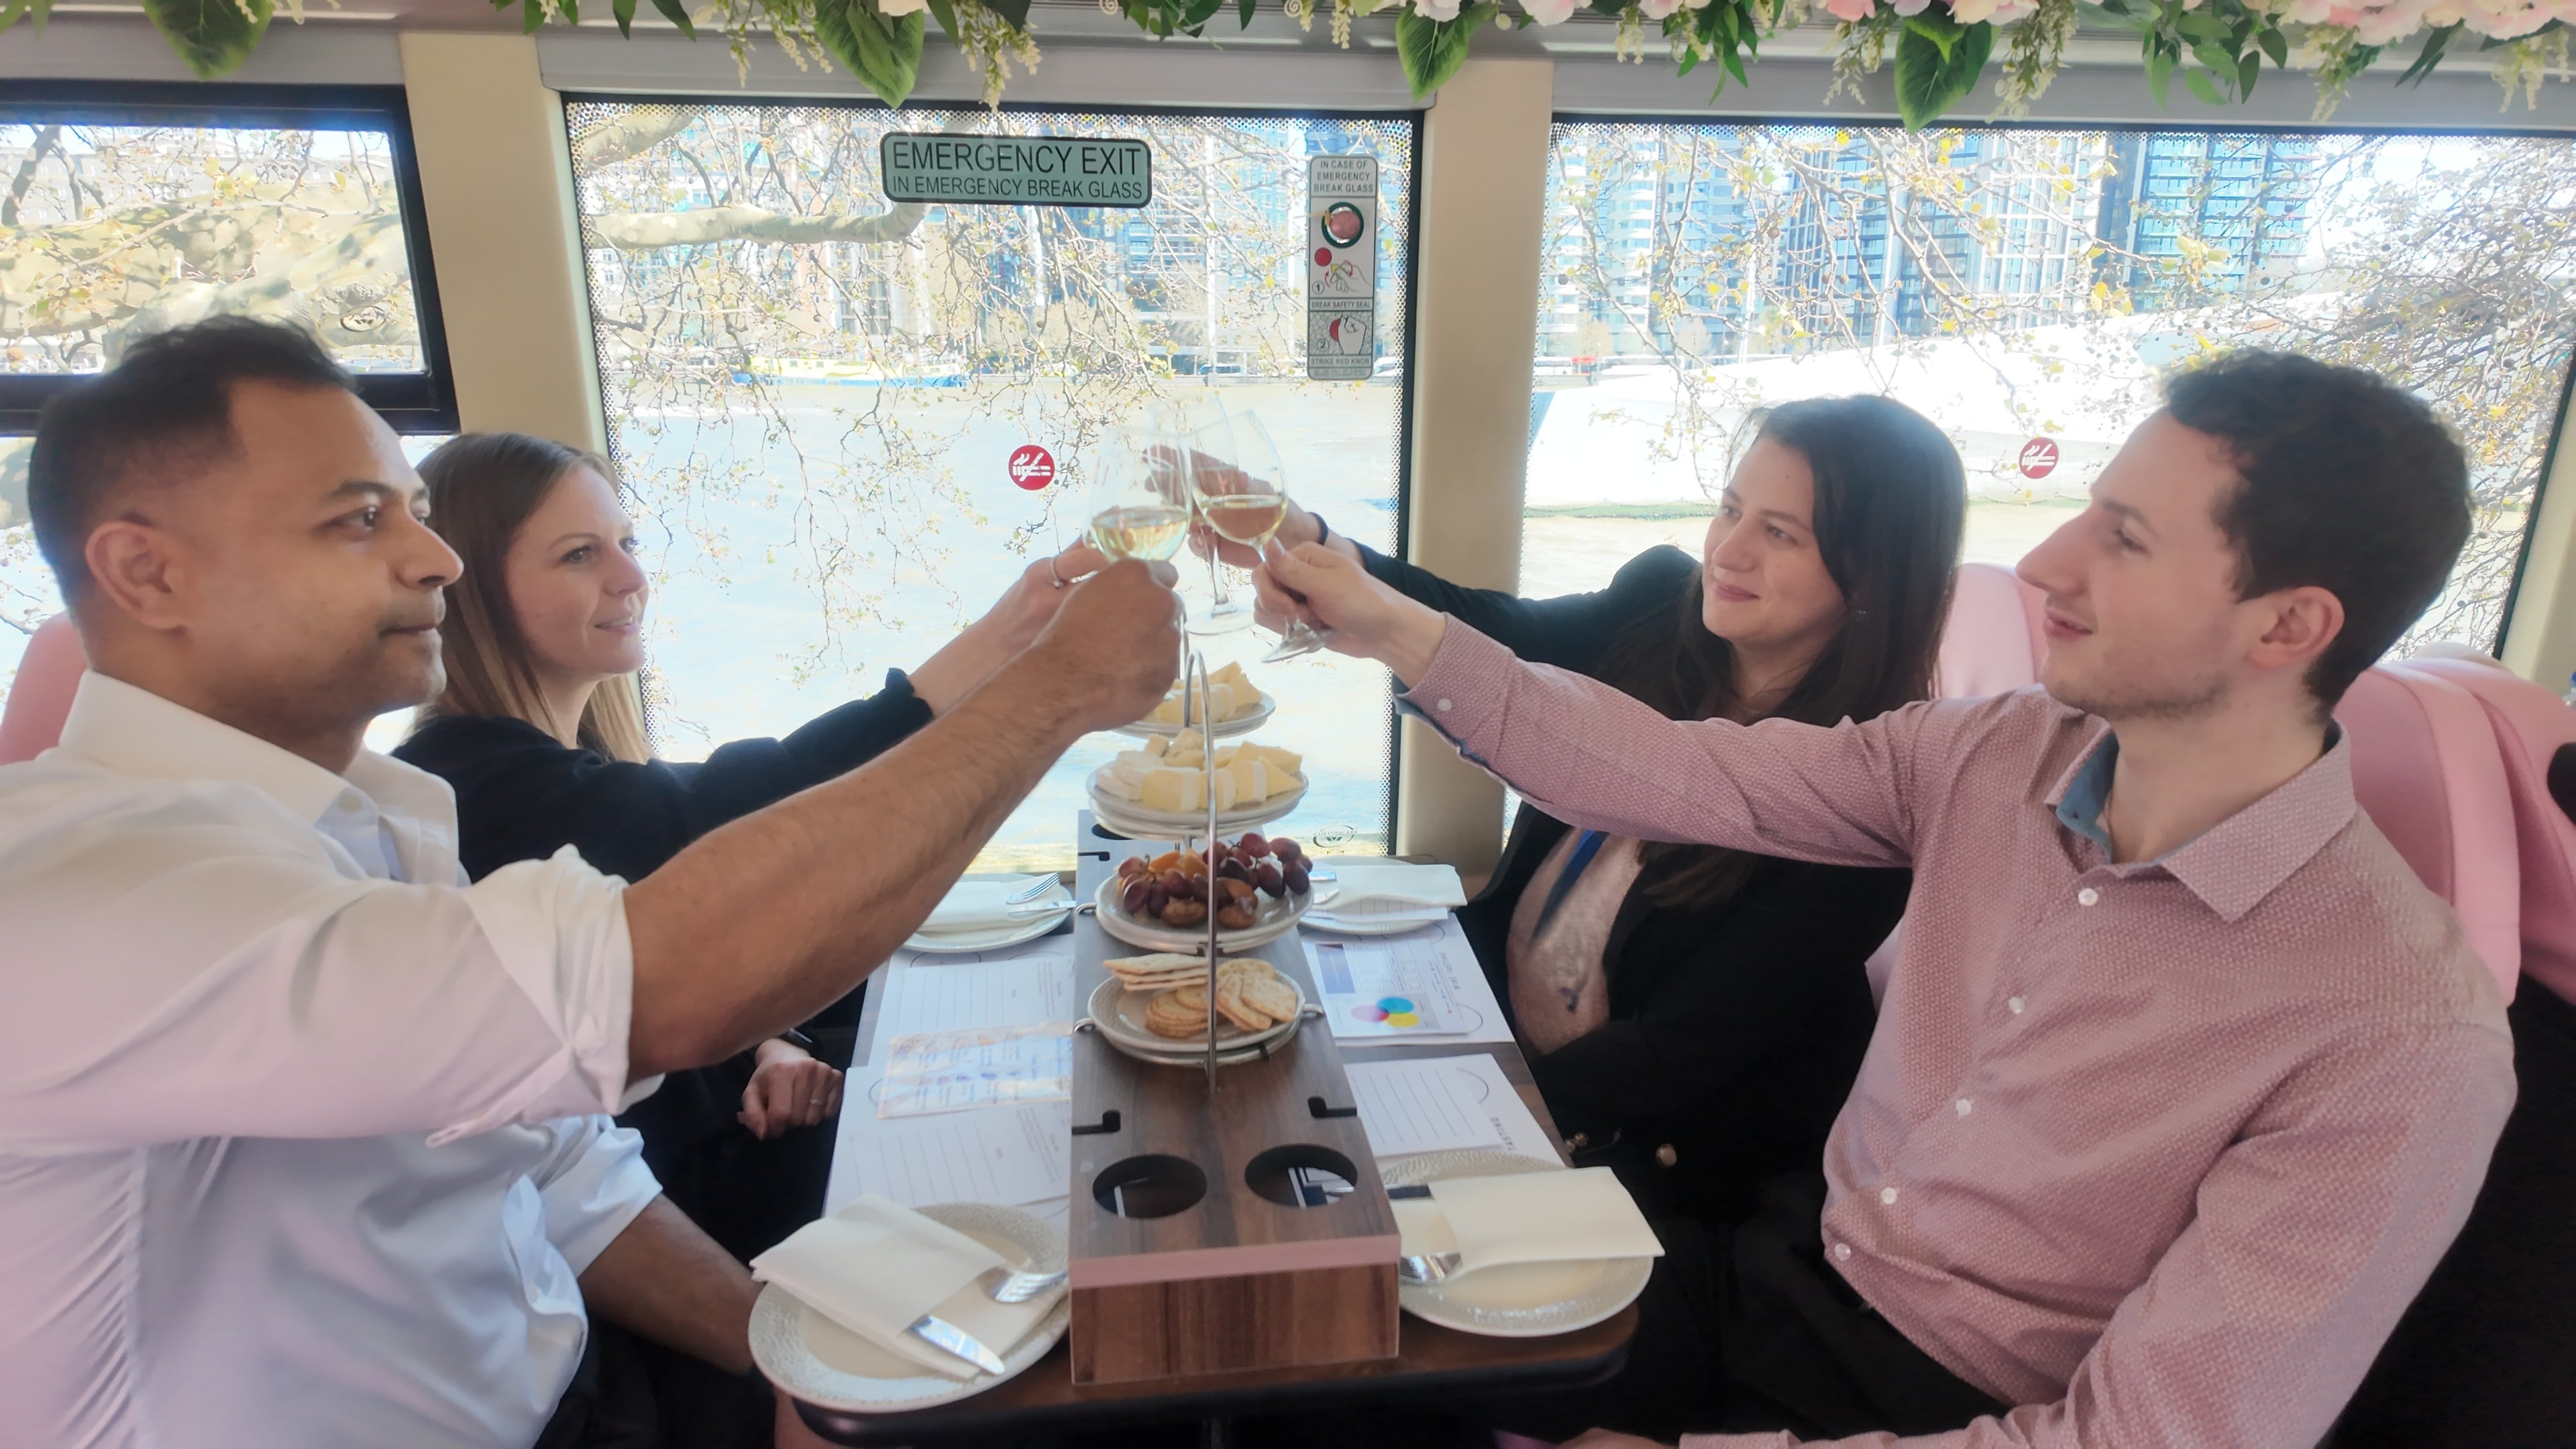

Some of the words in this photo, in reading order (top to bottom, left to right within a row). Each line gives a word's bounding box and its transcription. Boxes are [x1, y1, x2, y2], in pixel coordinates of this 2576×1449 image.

[893, 142, 1072, 173] EMERGENCY
[1082, 147, 1140, 175] EXIT
[1321, 160, 1328, 168] IN
[1332, 160, 1353, 168] CASE
[1356, 160, 1367, 168] OF
[1317, 172, 1371, 180] EMERGENCY
[893, 176, 909, 193] IN
[915, 176, 1022, 196] EMERGENCY
[1028, 180, 1083, 197] BREAK
[1088, 181, 1142, 199] GLASS
[1314, 184, 1342, 193] BREAK
[1345, 184, 1374, 193] GLASS
